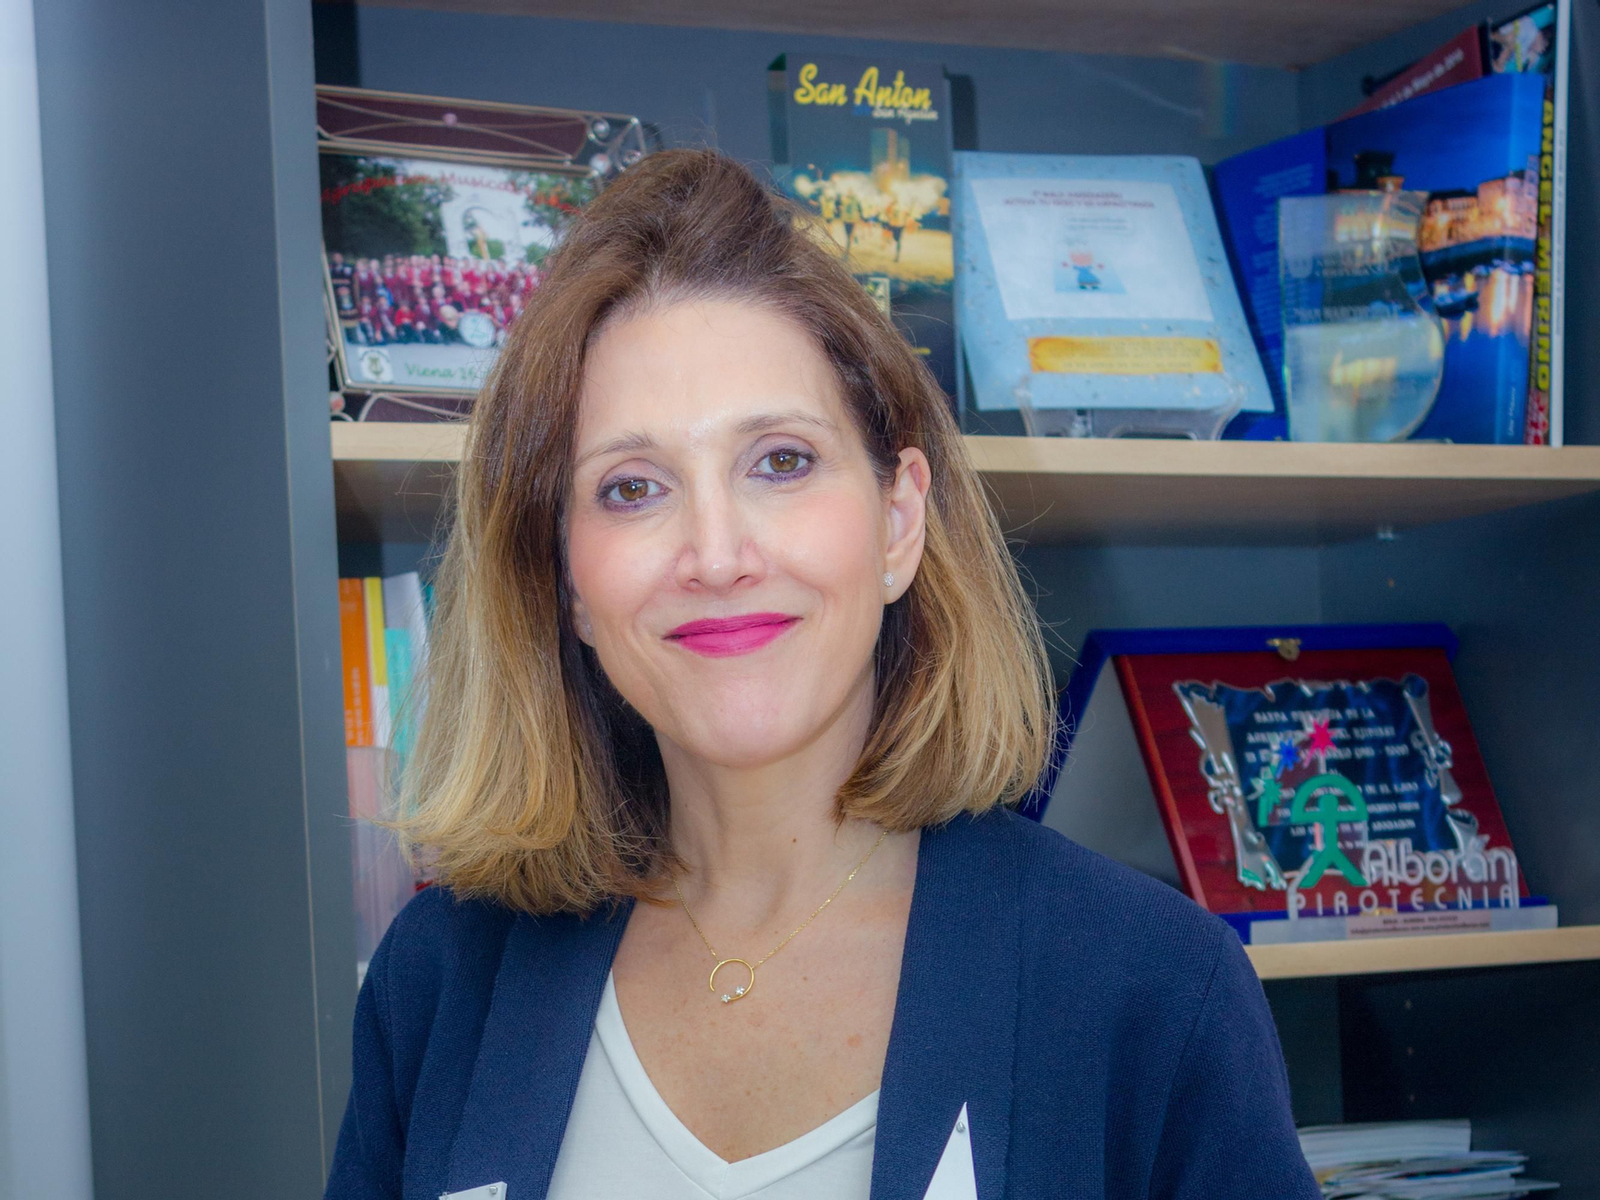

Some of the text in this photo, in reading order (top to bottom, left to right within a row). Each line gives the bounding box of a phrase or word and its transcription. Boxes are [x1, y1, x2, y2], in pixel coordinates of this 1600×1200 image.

[794, 62, 932, 109] San Anton
[1537, 99, 1554, 392] ANGEL MERINO
[1294, 882, 1515, 918] PIROTECNIA
